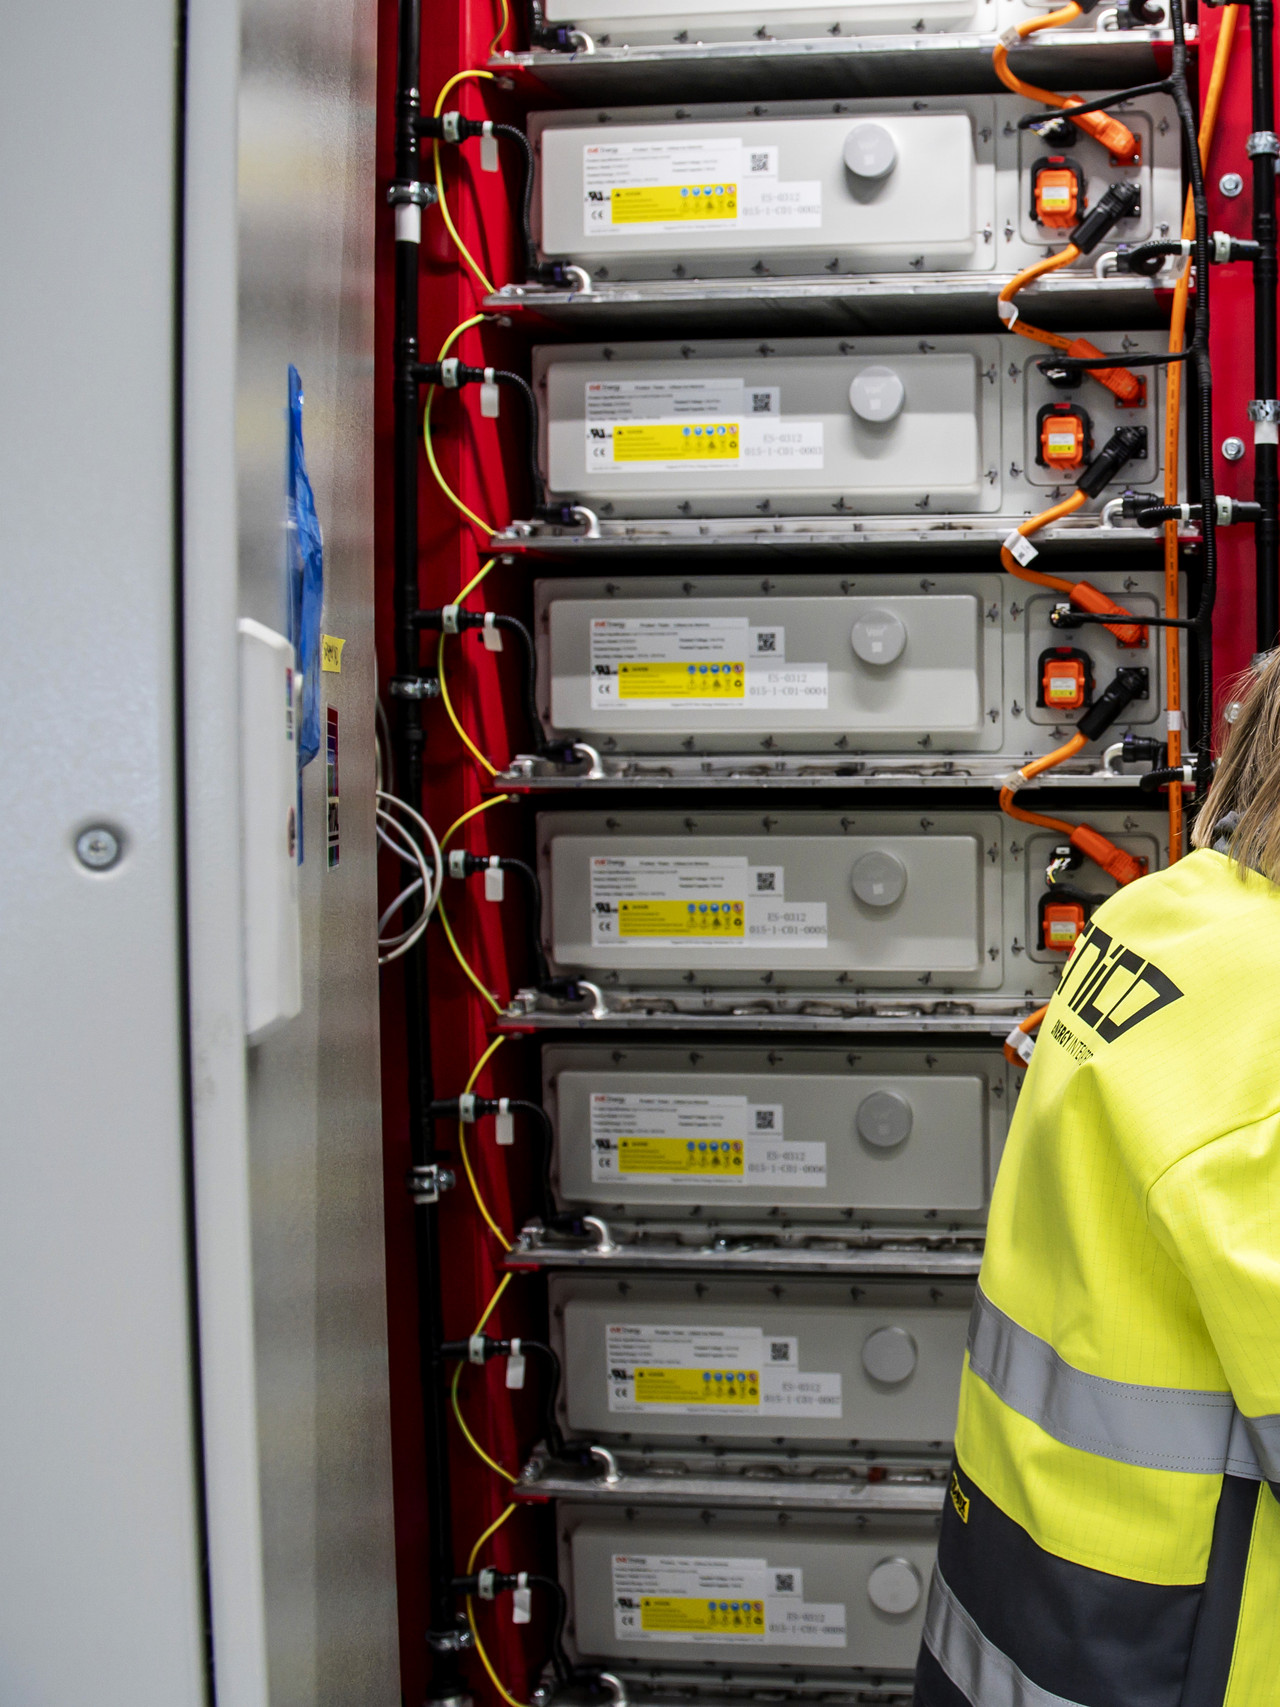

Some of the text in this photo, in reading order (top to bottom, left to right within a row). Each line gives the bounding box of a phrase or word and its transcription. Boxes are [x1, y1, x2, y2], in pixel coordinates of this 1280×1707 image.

[763, 434, 802, 443] ES-0312
[768, 674, 807, 683] ES-0312
[768, 913, 806, 922] ES-0312
